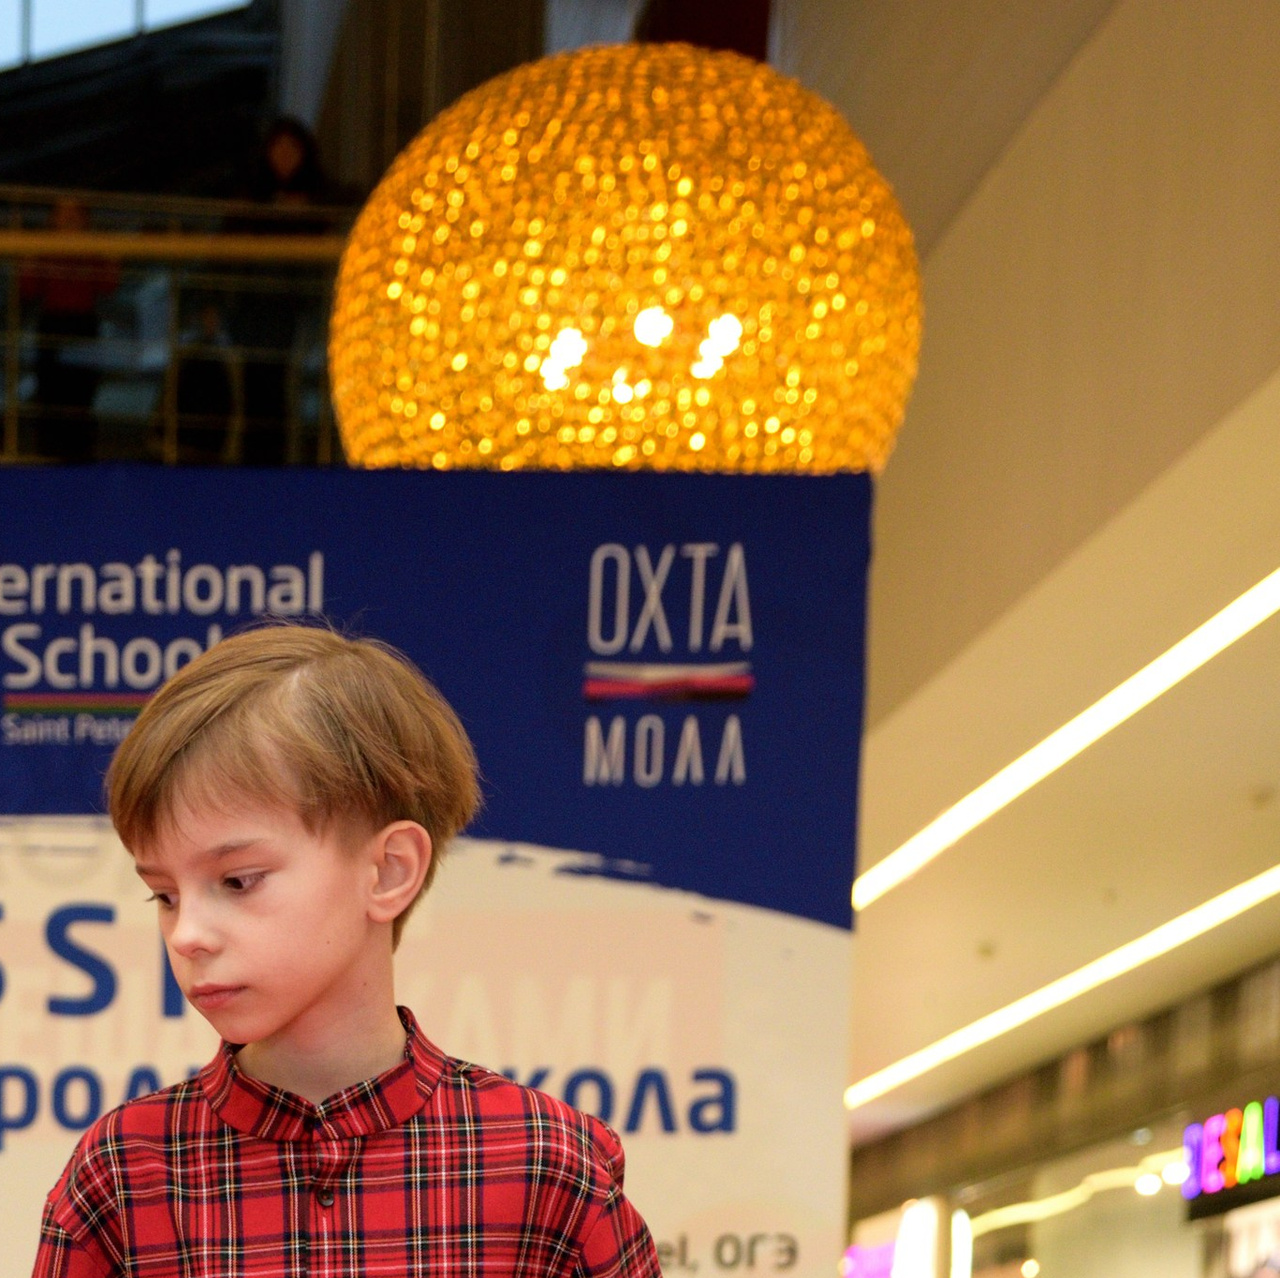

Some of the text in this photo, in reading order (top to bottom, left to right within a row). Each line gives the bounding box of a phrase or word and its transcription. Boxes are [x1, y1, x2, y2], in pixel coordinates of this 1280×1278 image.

[586, 542, 754, 656] ОХТА
[0, 713, 71, 745] Saint
[582, 713, 747, 789] МОЛЛ
[713, 1232, 799, 1271] ОГЭ
